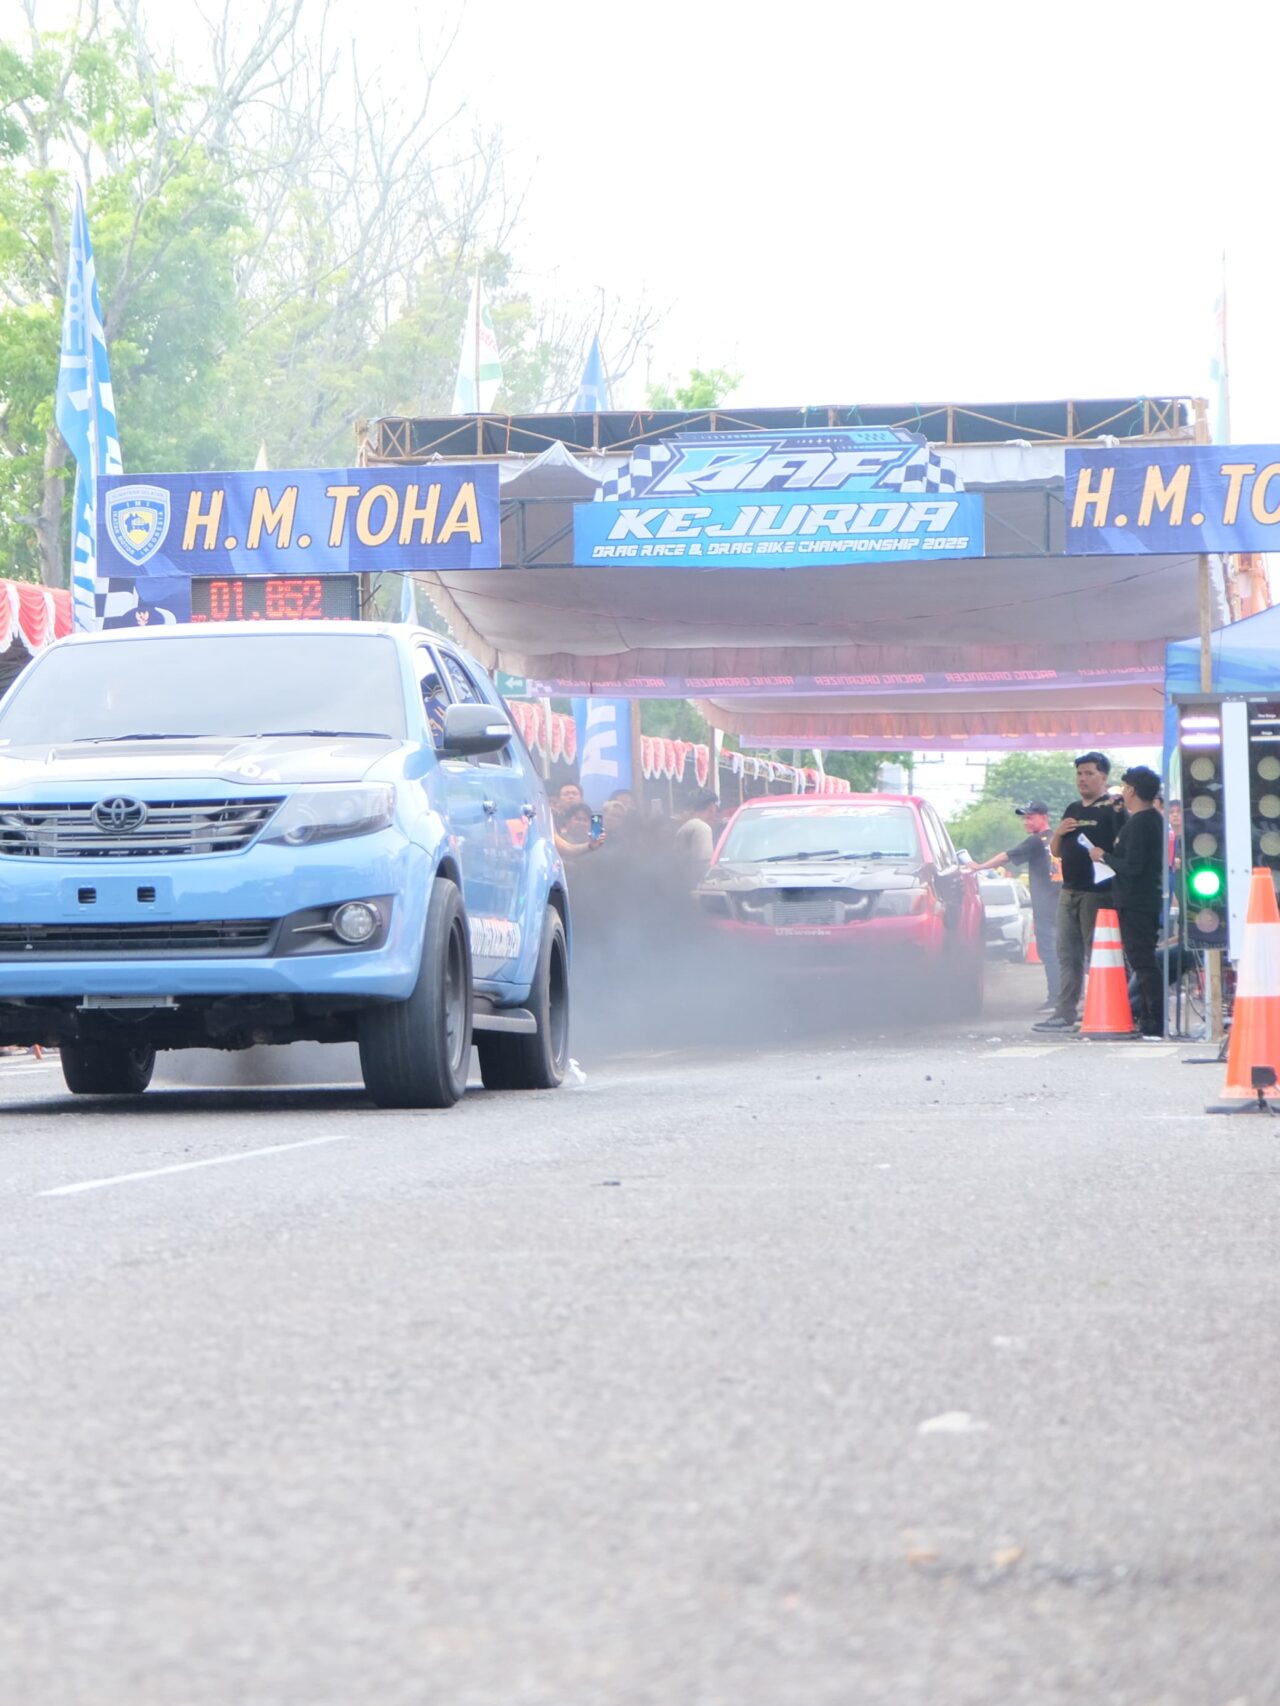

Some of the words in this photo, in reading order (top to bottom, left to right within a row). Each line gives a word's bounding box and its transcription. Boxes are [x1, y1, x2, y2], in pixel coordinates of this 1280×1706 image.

[182, 486, 312, 552] H.M.
[326, 482, 483, 548] TOHA
[607, 501, 959, 540] KEJURDA
[1070, 464, 1206, 528] H.M.
[592, 545, 638, 558] DRAG
[640, 543, 686, 556] RACE
[688, 543, 703, 556] &
[707, 542, 753, 555] DRAG
[756, 541, 795, 553] BIKE
[799, 538, 919, 553] CHAMPIONSHIP
[922, 536, 969, 550] 2025
